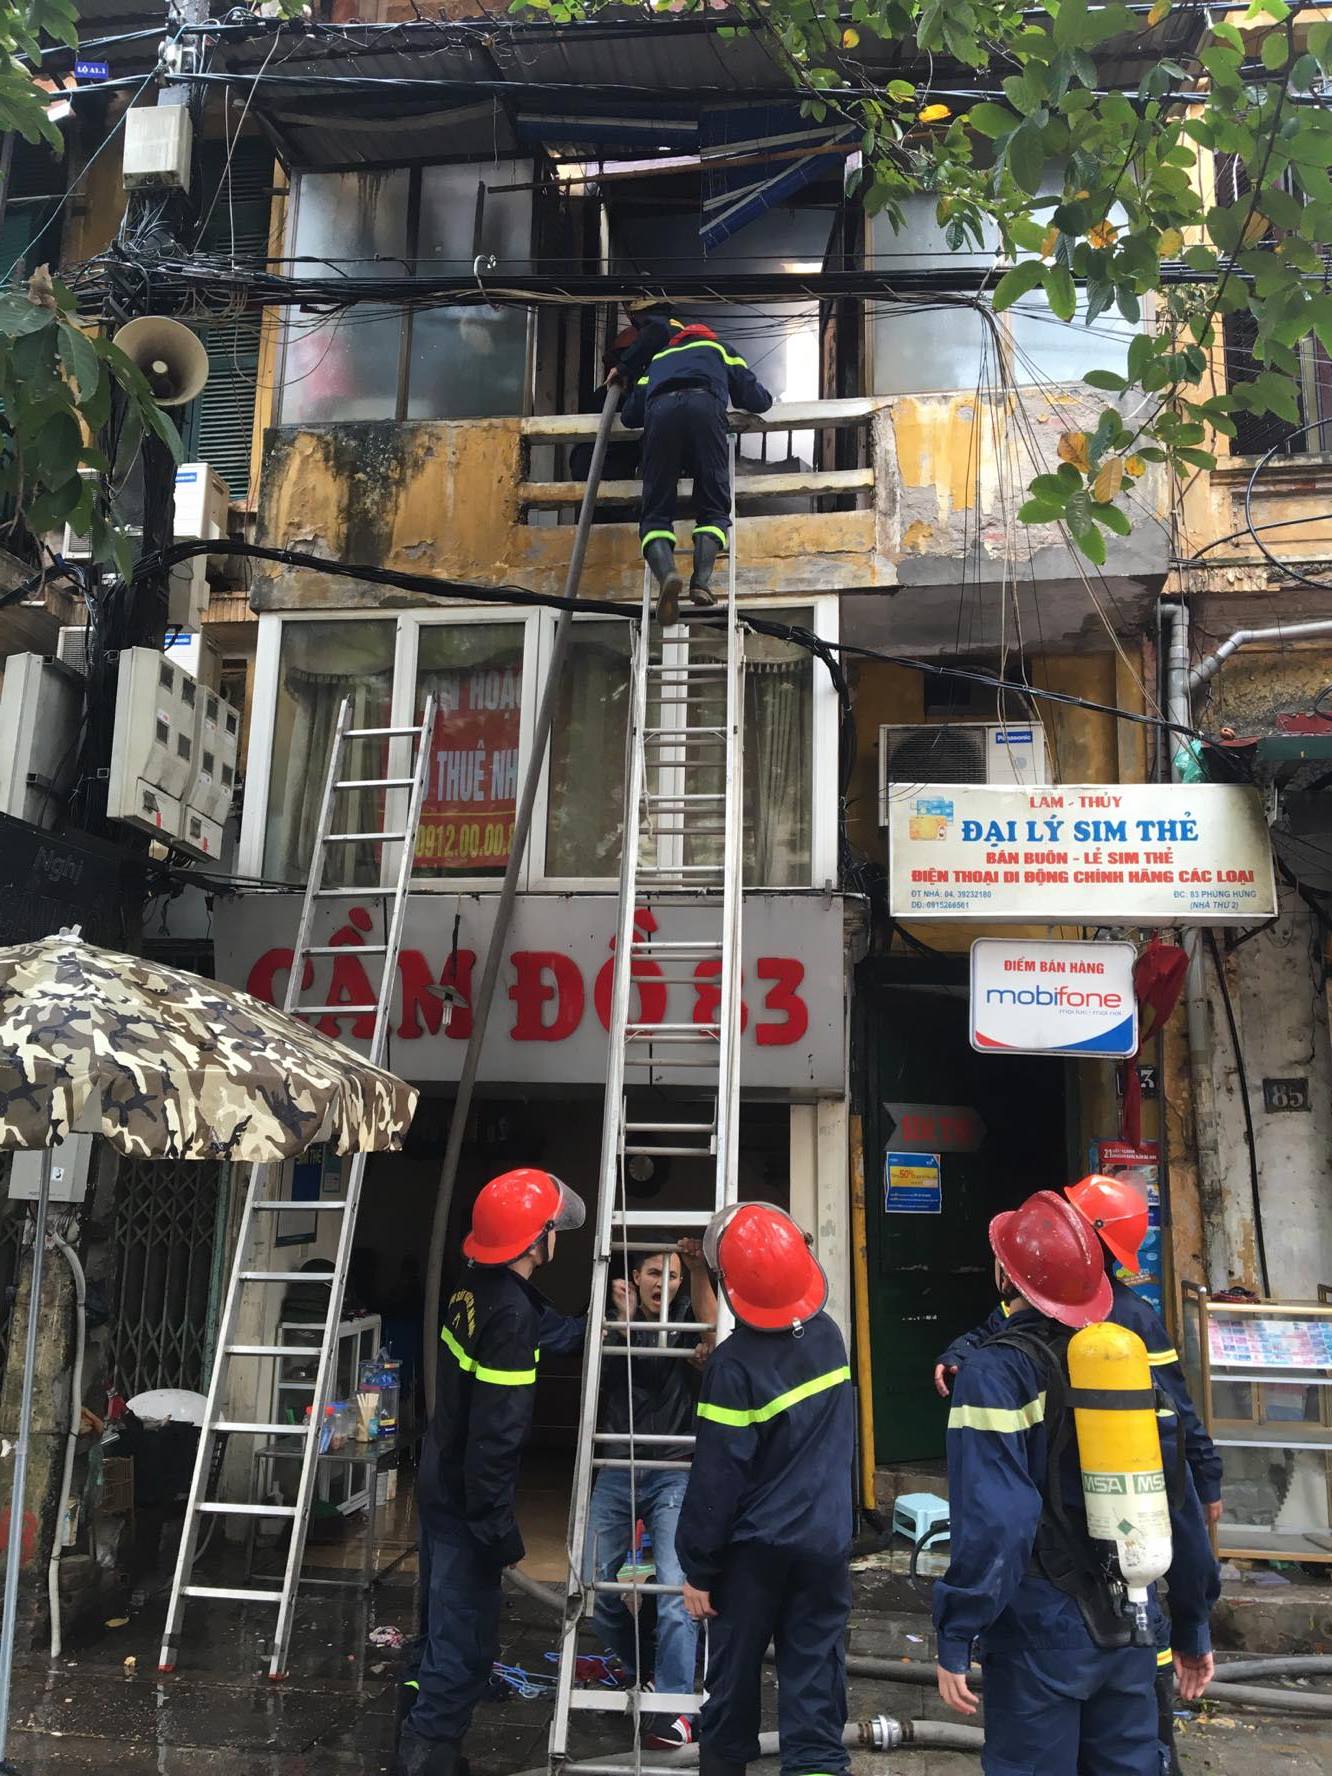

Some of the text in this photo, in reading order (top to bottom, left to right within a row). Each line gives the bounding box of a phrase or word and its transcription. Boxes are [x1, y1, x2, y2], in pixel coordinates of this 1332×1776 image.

[961, 811, 1199, 848] ĐẠI LÝ SIM THẺ
[1107, 851, 1139, 865] SIM
[1003, 871, 1020, 883] DI
[1178, 868, 1213, 884] CÁC
[1217, 870, 1255, 886] LOẠI
[693, 957, 808, 1046] 83
[986, 984, 1122, 1009] mobifone
[1083, 1474, 1165, 1493] MSA MS
